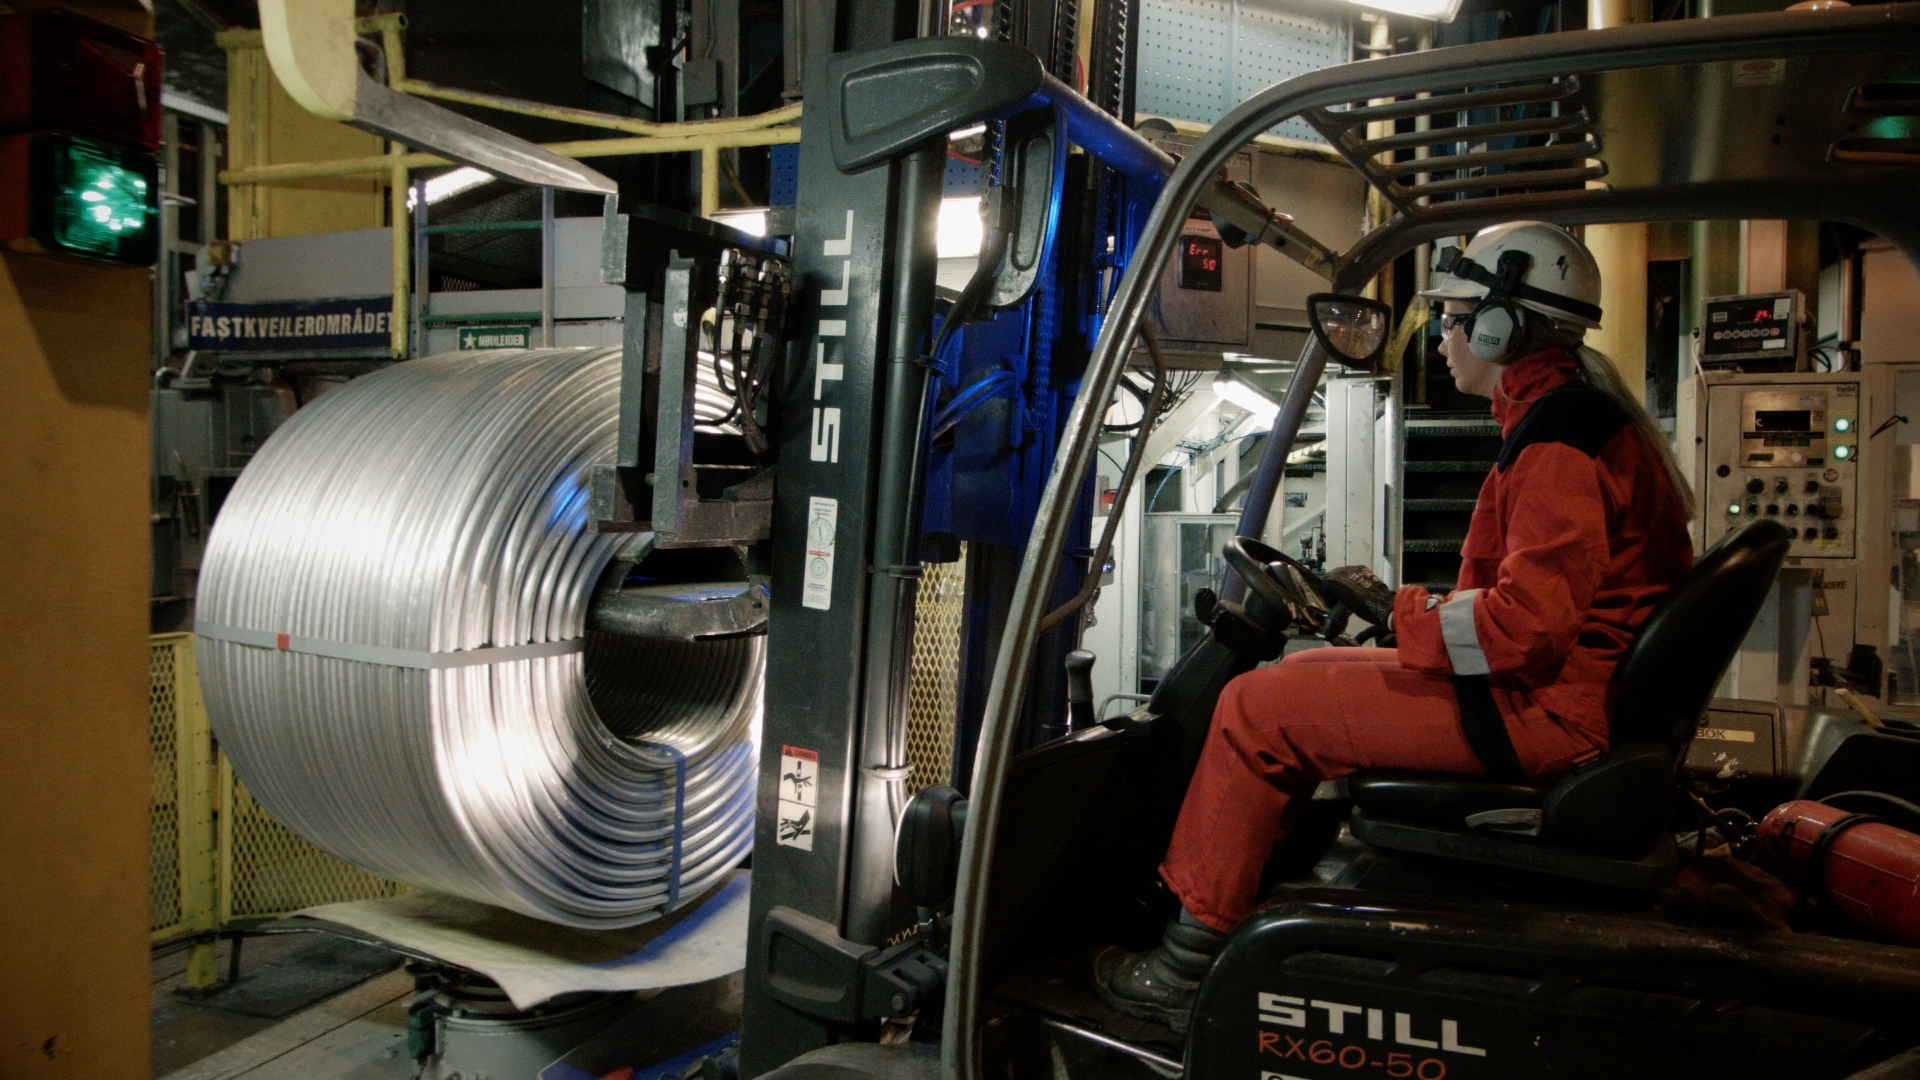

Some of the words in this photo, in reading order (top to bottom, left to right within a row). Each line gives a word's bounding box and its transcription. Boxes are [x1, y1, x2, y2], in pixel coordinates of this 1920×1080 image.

[810, 209, 854, 463] STILL
[1258, 991, 1487, 1057] STILL
[1258, 1030, 1447, 1080] RX60-50
